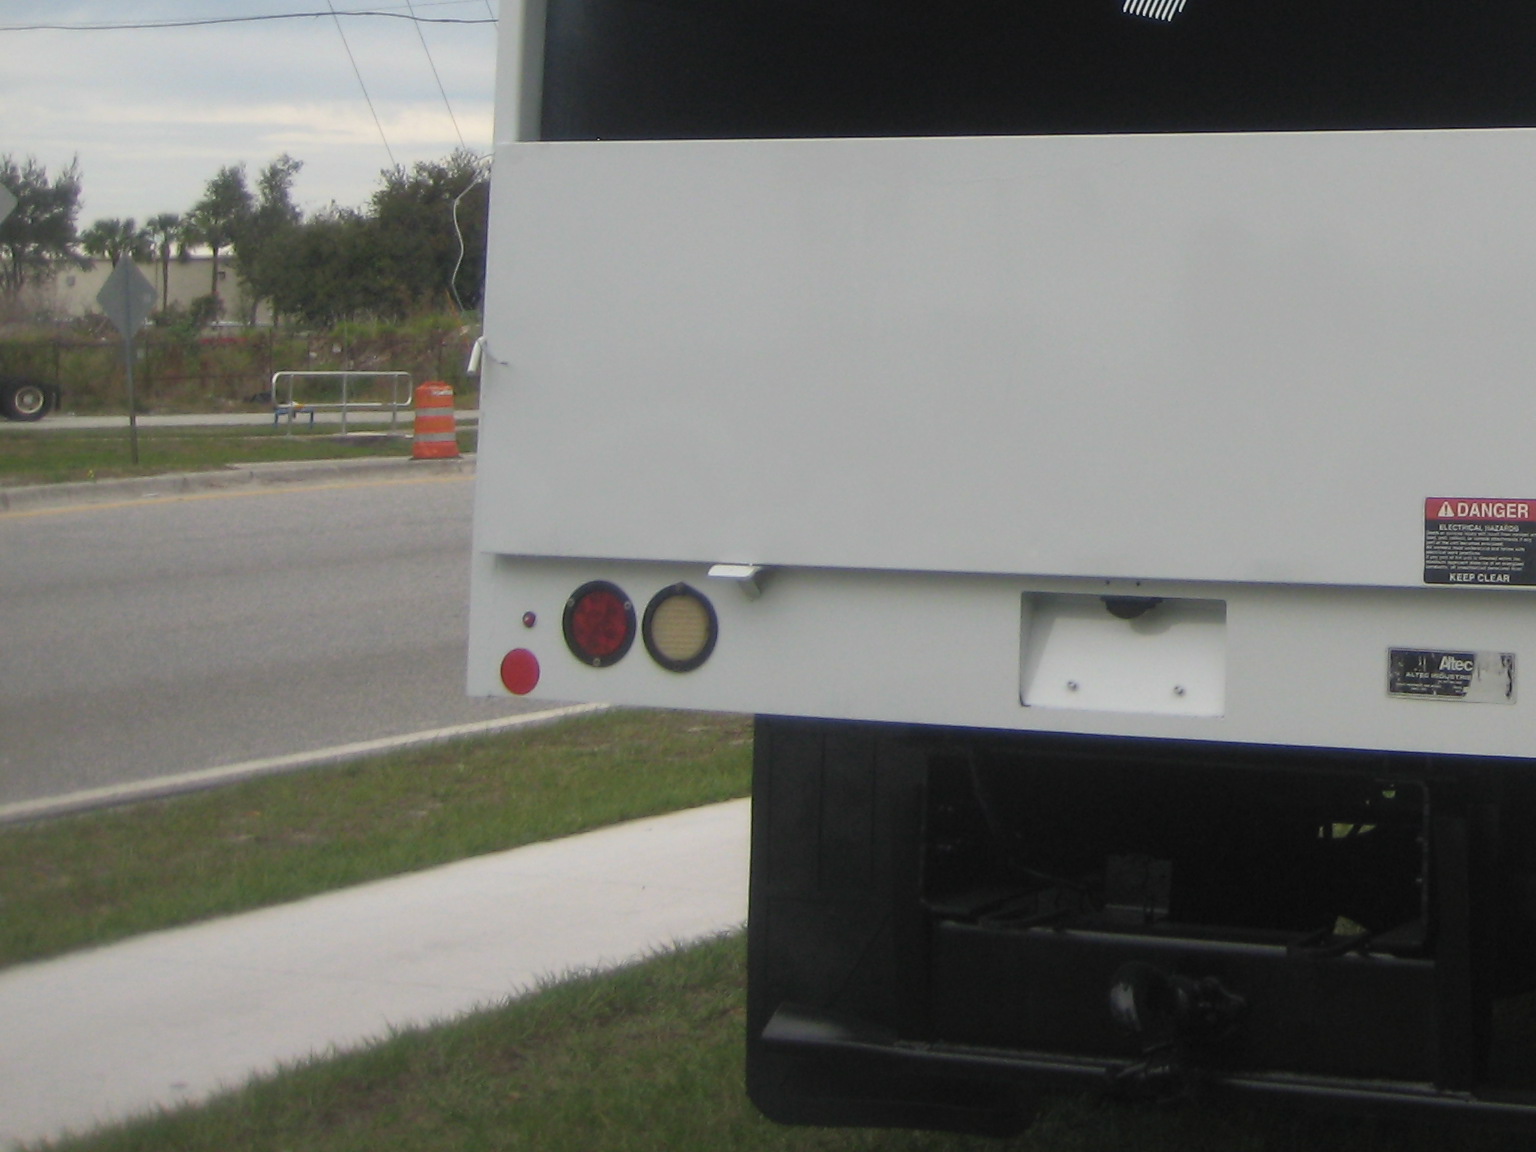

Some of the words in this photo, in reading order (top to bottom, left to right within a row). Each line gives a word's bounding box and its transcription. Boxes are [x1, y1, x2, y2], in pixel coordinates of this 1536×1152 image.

[1457, 502, 1529, 519] DANGER
[1449, 572, 1475, 582] KEEP
[1477, 573, 1510, 583] CLEAR
[1439, 655, 1474, 672] Altec
